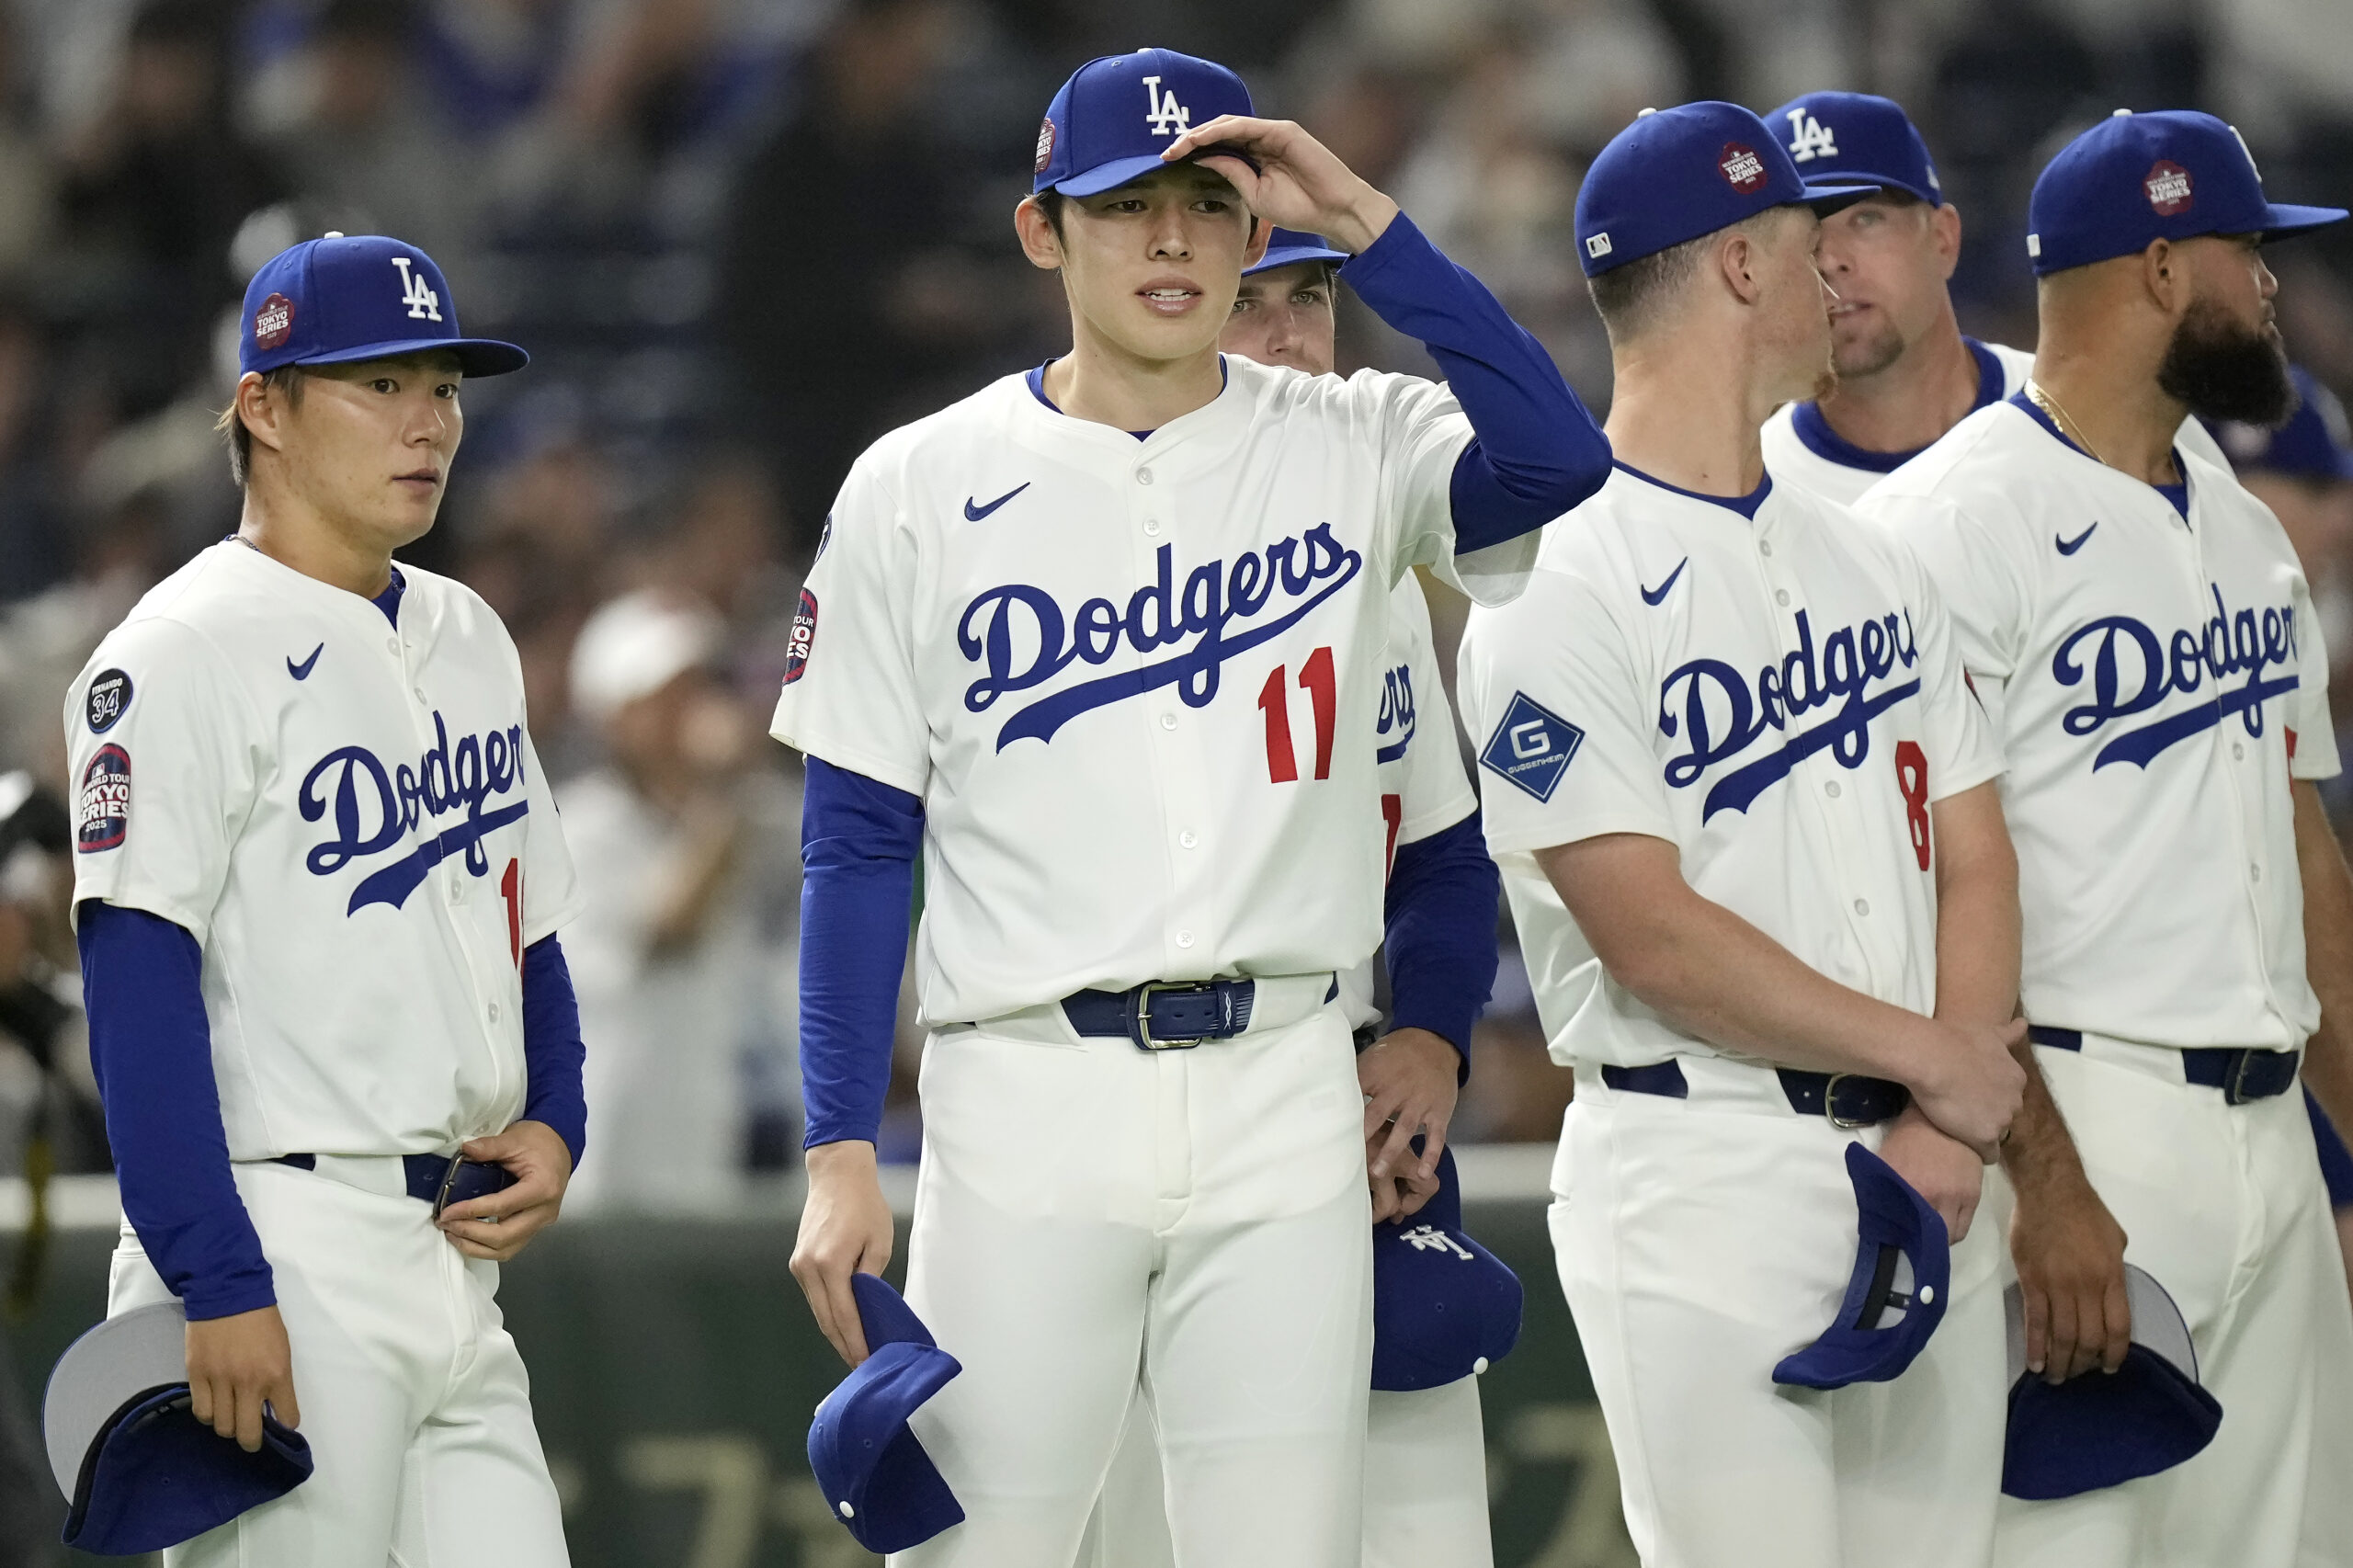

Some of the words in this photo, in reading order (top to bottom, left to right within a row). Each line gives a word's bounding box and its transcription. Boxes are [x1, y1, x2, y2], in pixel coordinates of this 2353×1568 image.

[1142, 75, 1192, 136] LA
[1786, 107, 1839, 163] LA
[1725, 156, 1757, 175] TOKYO
[1729, 163, 1763, 184] SERIES
[2149, 178, 2188, 194] TOKYO
[2151, 187, 2191, 204] SERIES
[391, 257, 443, 323] LA
[256, 311, 288, 328] TOKYO
[256, 318, 289, 337] SERIES
[957, 521, 1362, 713] Dodgers
[2052, 581, 2297, 739] Dodger
[91, 687, 120, 724] 34
[1257, 645, 1336, 784] 11
[1507, 753, 1565, 775] GUGGENHEIM
[299, 710, 526, 878] Dodger
[85, 819, 108, 833] 2025
